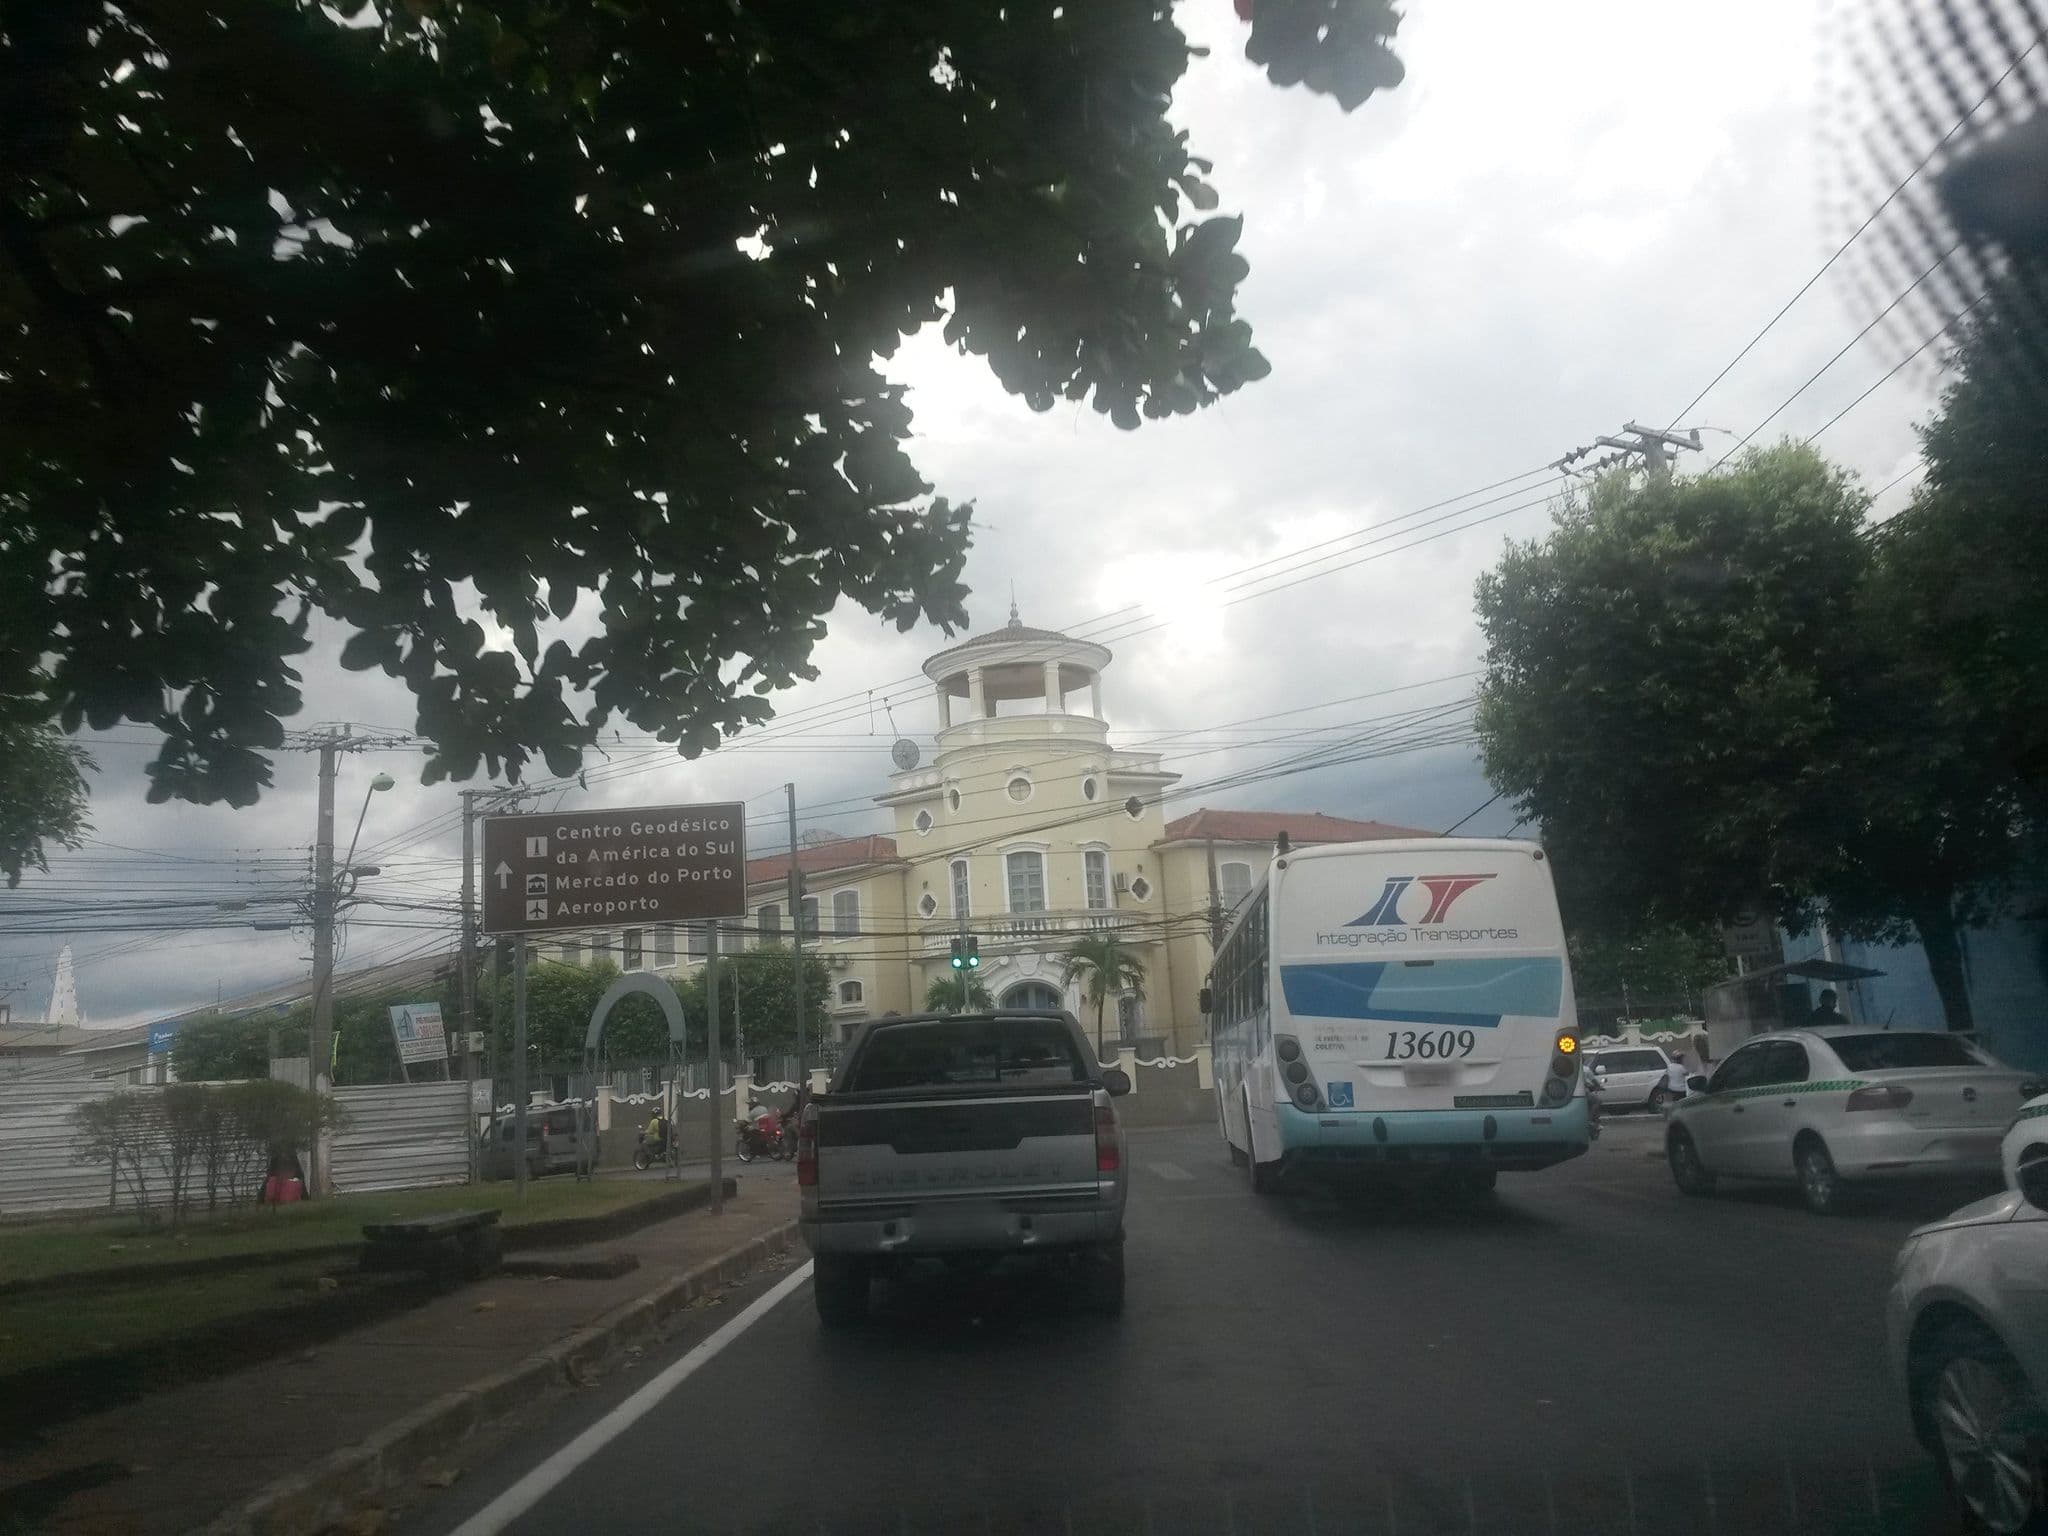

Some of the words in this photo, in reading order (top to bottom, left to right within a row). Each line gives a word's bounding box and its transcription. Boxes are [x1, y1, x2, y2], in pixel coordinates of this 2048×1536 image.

[556, 824, 622, 840] Centro
[630, 818, 729, 836] Geodésico
[556, 851, 578, 864] da
[587, 845, 670, 862] América
[676, 843, 699, 857] do
[705, 840, 735, 855] Sul
[556, 872, 639, 890] Mercado
[648, 870, 670, 884] do
[677, 867, 732, 882] Porto
[556, 897, 659, 916] Aeroporto
[1316, 928, 1408, 947] Integração
[1410, 927, 1519, 944] Transportes
[1384, 1029, 1476, 1060] 13609
